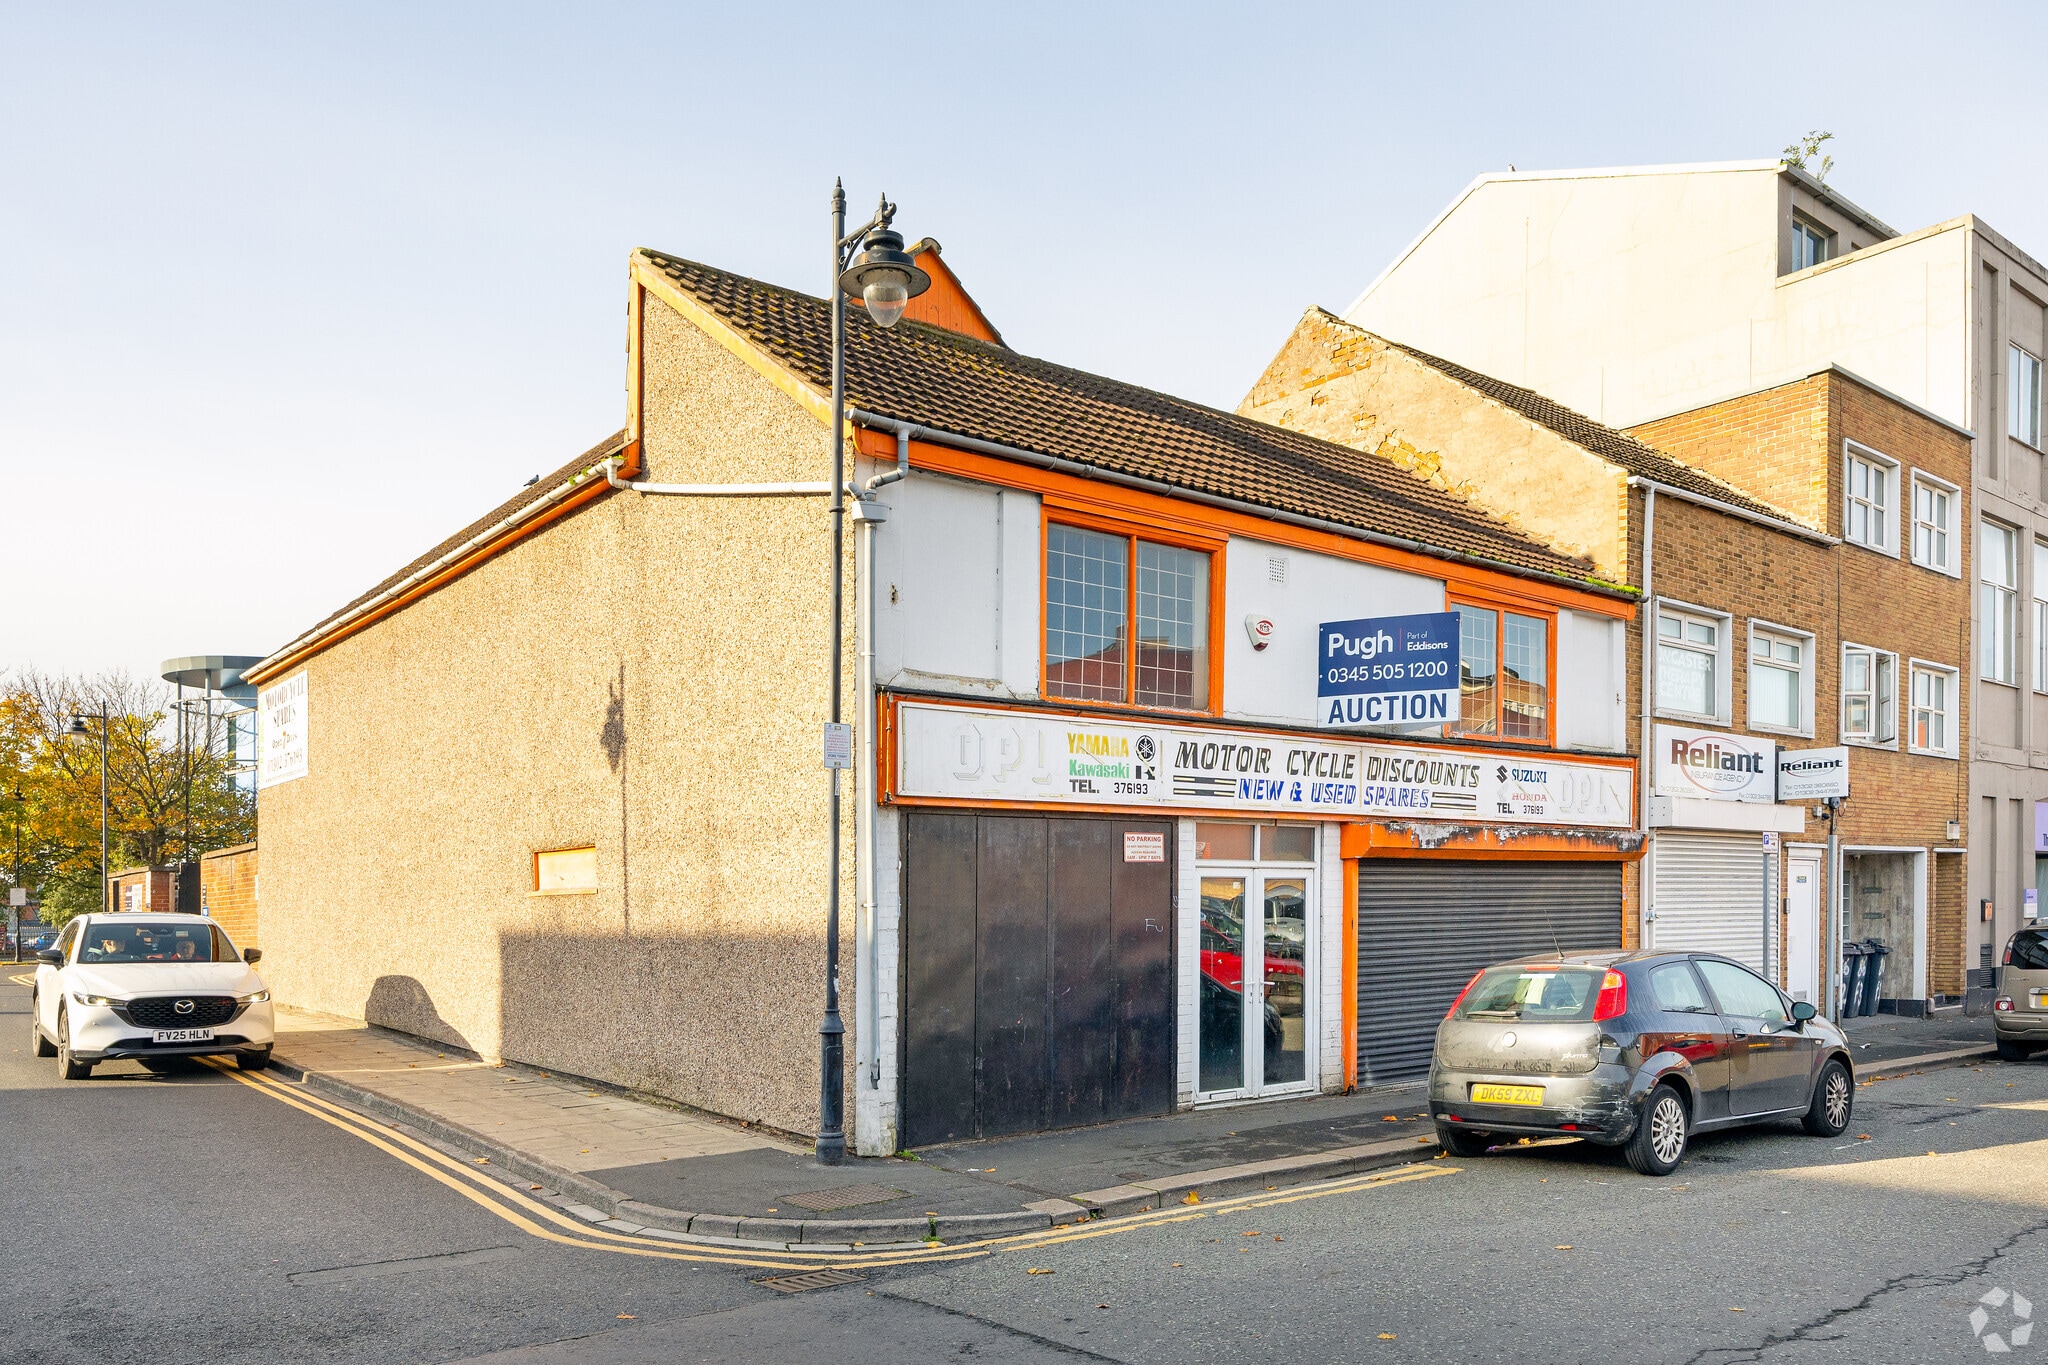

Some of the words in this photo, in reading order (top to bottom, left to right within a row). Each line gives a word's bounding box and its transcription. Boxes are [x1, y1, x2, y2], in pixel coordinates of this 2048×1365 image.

[1407, 632, 1420, 640] Part
[1420, 631, 1428, 639] of
[1328, 629, 1394, 660] Pugh
[1407, 641, 1449, 651] Eddisons
[1328, 666, 1369, 683] 0345
[1372, 663, 1404, 680] 505
[1407, 660, 1448, 678] 1200
[1328, 693, 1447, 724] AUCTION
[282, 731, 287, 750] 7
[1067, 732, 1129, 757] YAMAHA
[1671, 738, 1764, 774] Reliant
[1069, 759, 1130, 779] Kawasaki
[1175, 741, 1271, 773] MOTOR
[1287, 749, 1356, 780] CYCLE
[1366, 756, 1480, 788] DISCOUNTS
[1780, 759, 1843, 771] Reliant
[1511, 768, 1547, 784] SUZUKI
[1691, 770, 1723, 781] INSURANCE
[1723, 773, 1746, 783] AGENCY
[1069, 779, 1100, 793] TEL.
[1114, 782, 1148, 794] 376193
[1238, 778, 1285, 800] NEW
[1290, 781, 1303, 802] &
[1311, 782, 1357, 804] USED
[1364, 786, 1430, 808] SPARES
[1512, 792, 1547, 802] HONDA
[1497, 802, 1515, 814] TEL.
[1523, 805, 1544, 815] 376193
[158, 1031, 187, 1041] FV25
[189, 1029, 210, 1040] HLN
[1480, 1087, 1512, 1101] DK59
[1514, 1089, 1539, 1102] ZXL
